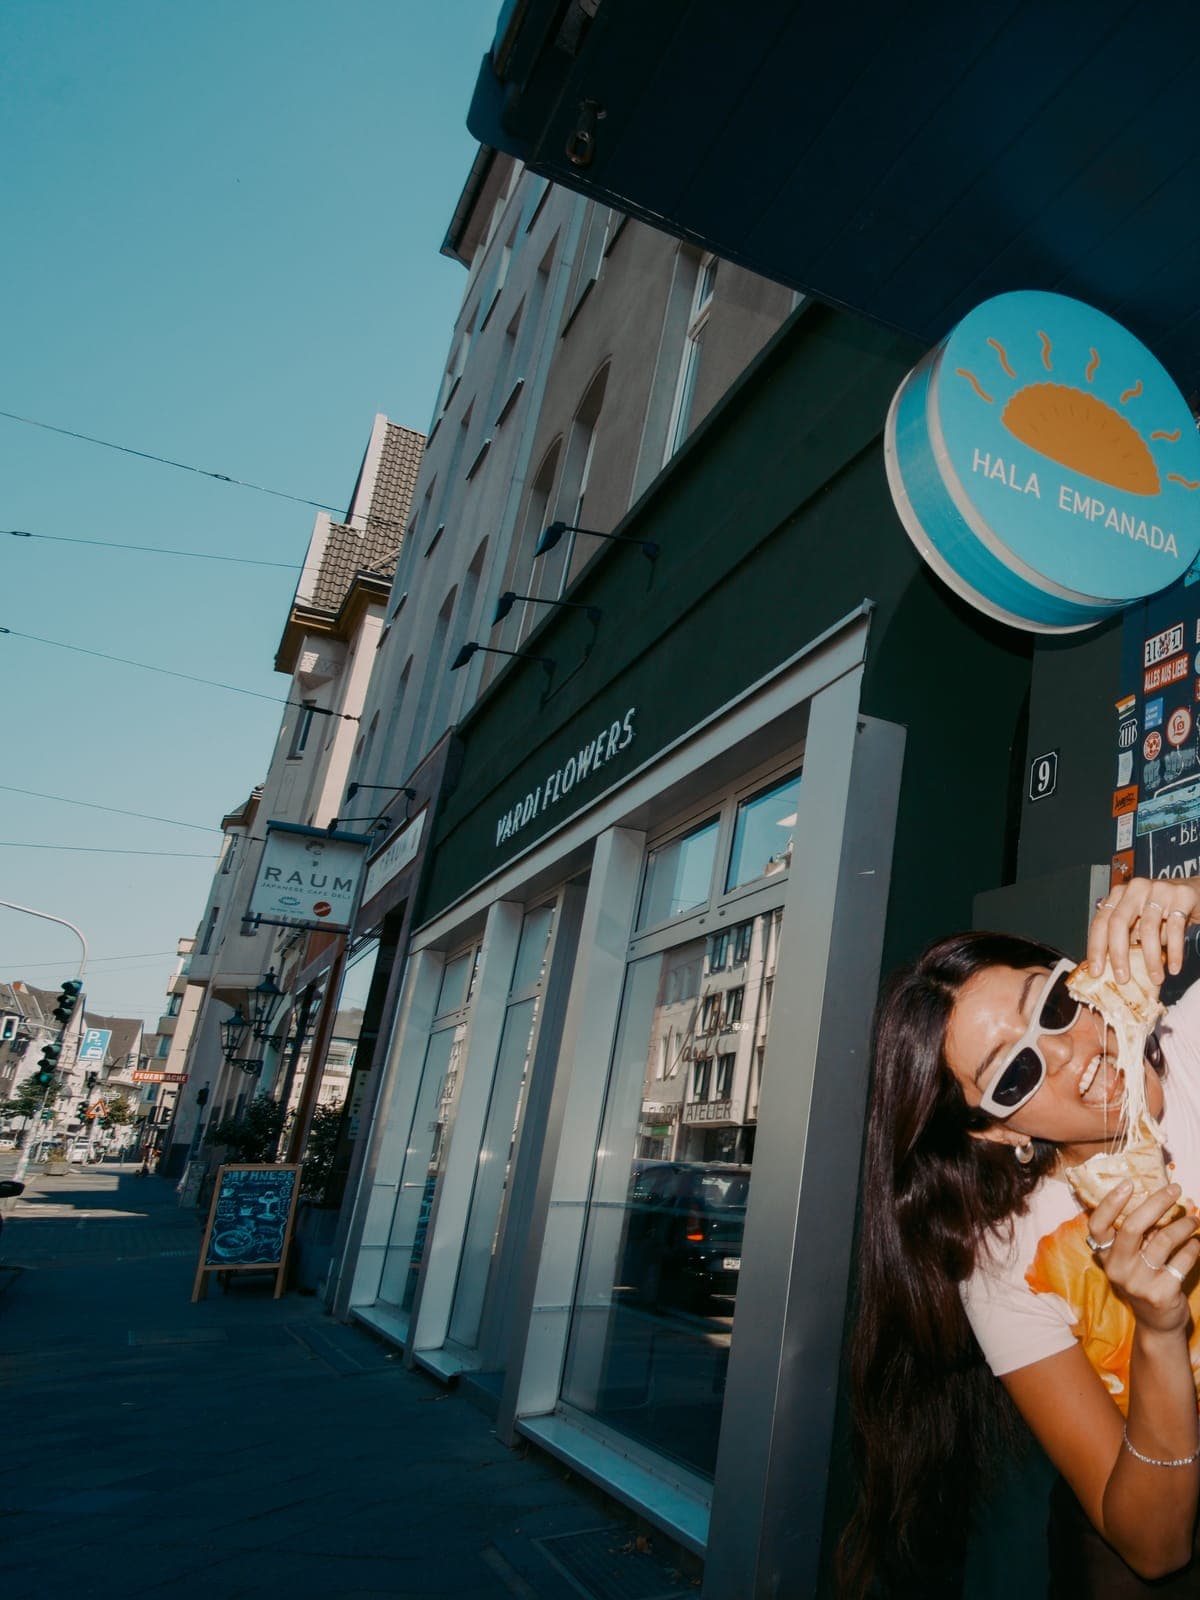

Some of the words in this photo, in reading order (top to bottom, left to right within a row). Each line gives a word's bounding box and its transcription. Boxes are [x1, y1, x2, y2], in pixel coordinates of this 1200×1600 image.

[972, 447, 1041, 499] HALA
[1058, 484, 1180, 559] EMPANADA
[541, 707, 636, 811] FLOWERS
[1038, 761, 1050, 792] 9
[261, 882, 304, 893] JAPANESE
[264, 866, 354, 893] RAUM
[87, 1030, 100, 1043] P
